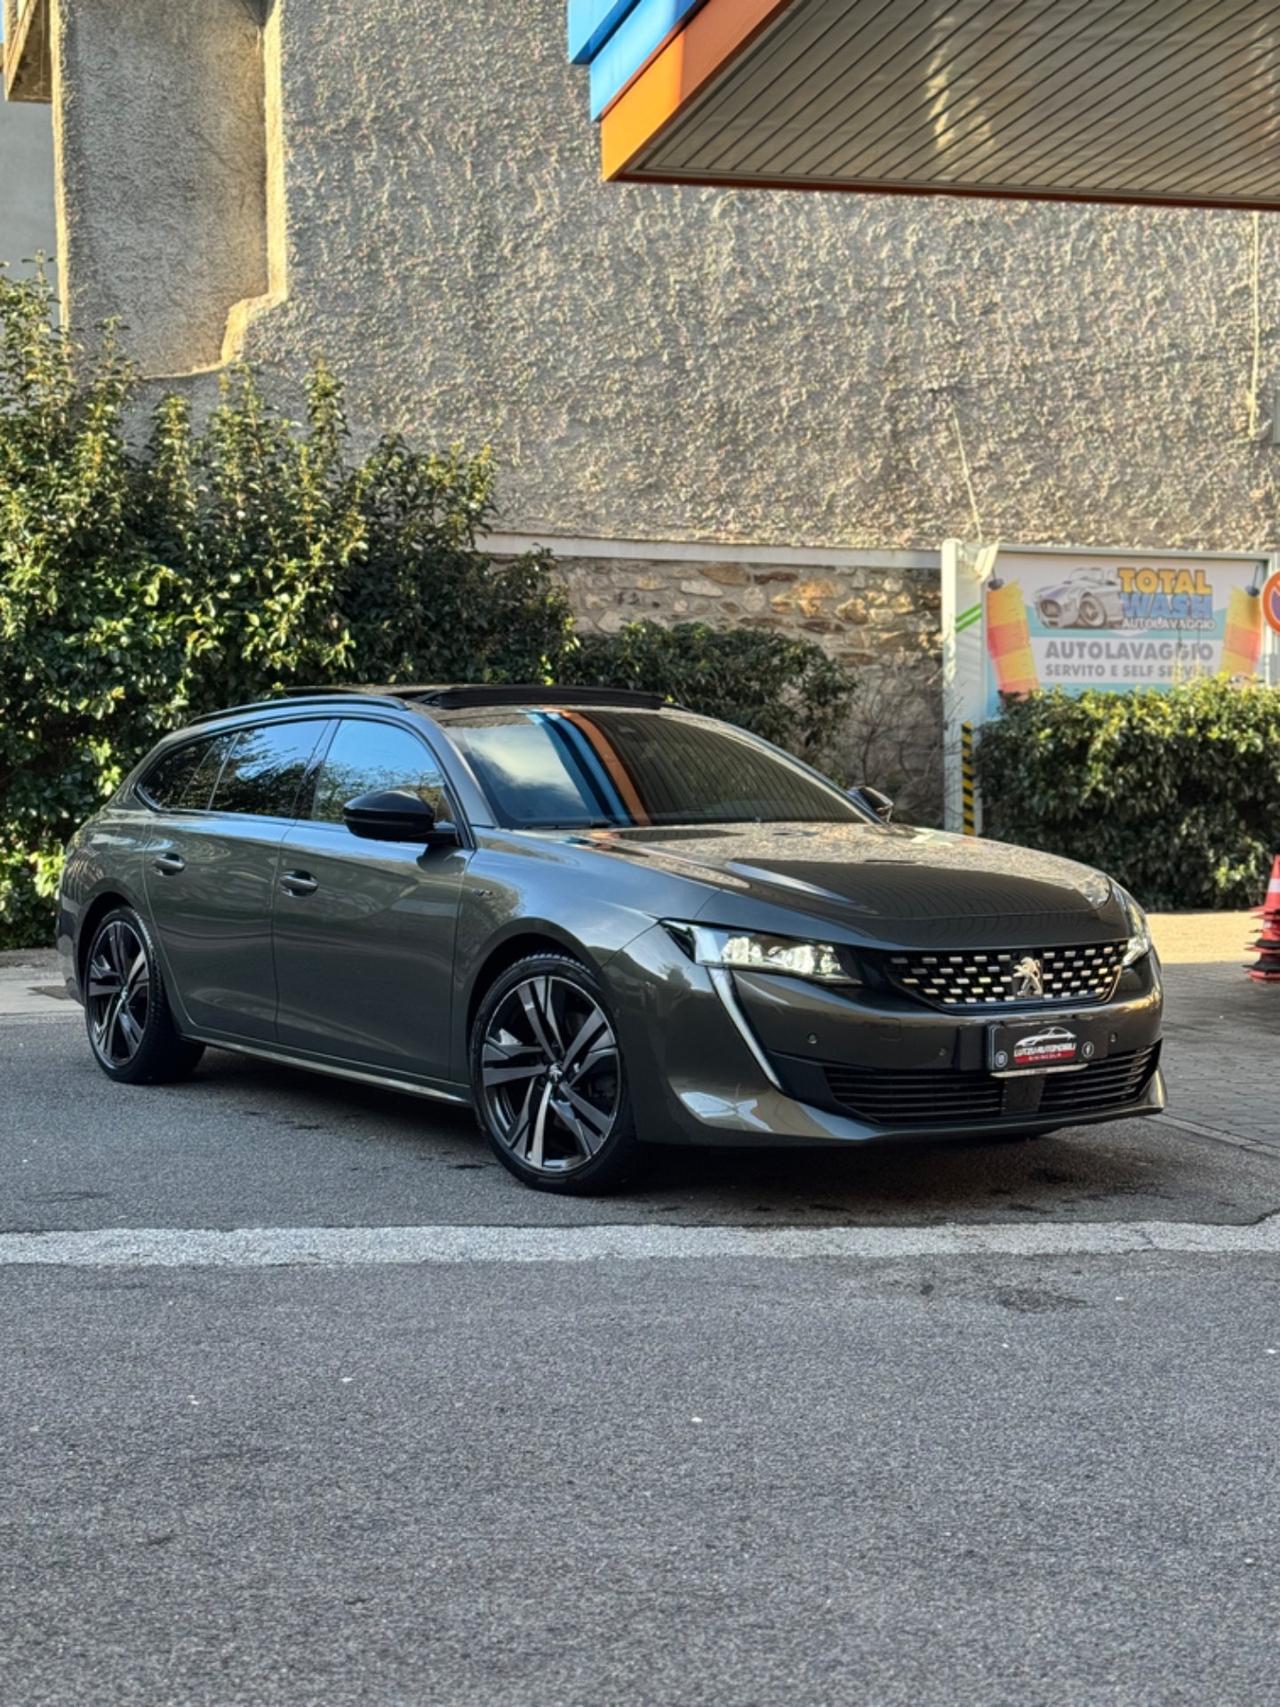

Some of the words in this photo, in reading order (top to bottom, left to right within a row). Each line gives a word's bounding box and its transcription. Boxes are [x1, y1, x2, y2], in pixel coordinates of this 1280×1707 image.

[1117, 566, 1213, 595] TOTAL
[1119, 593, 1213, 619] WASH
[1045, 664, 1105, 677] SERVITO
[1110, 665, 1118, 677] E
[1123, 665, 1154, 678] SELF
